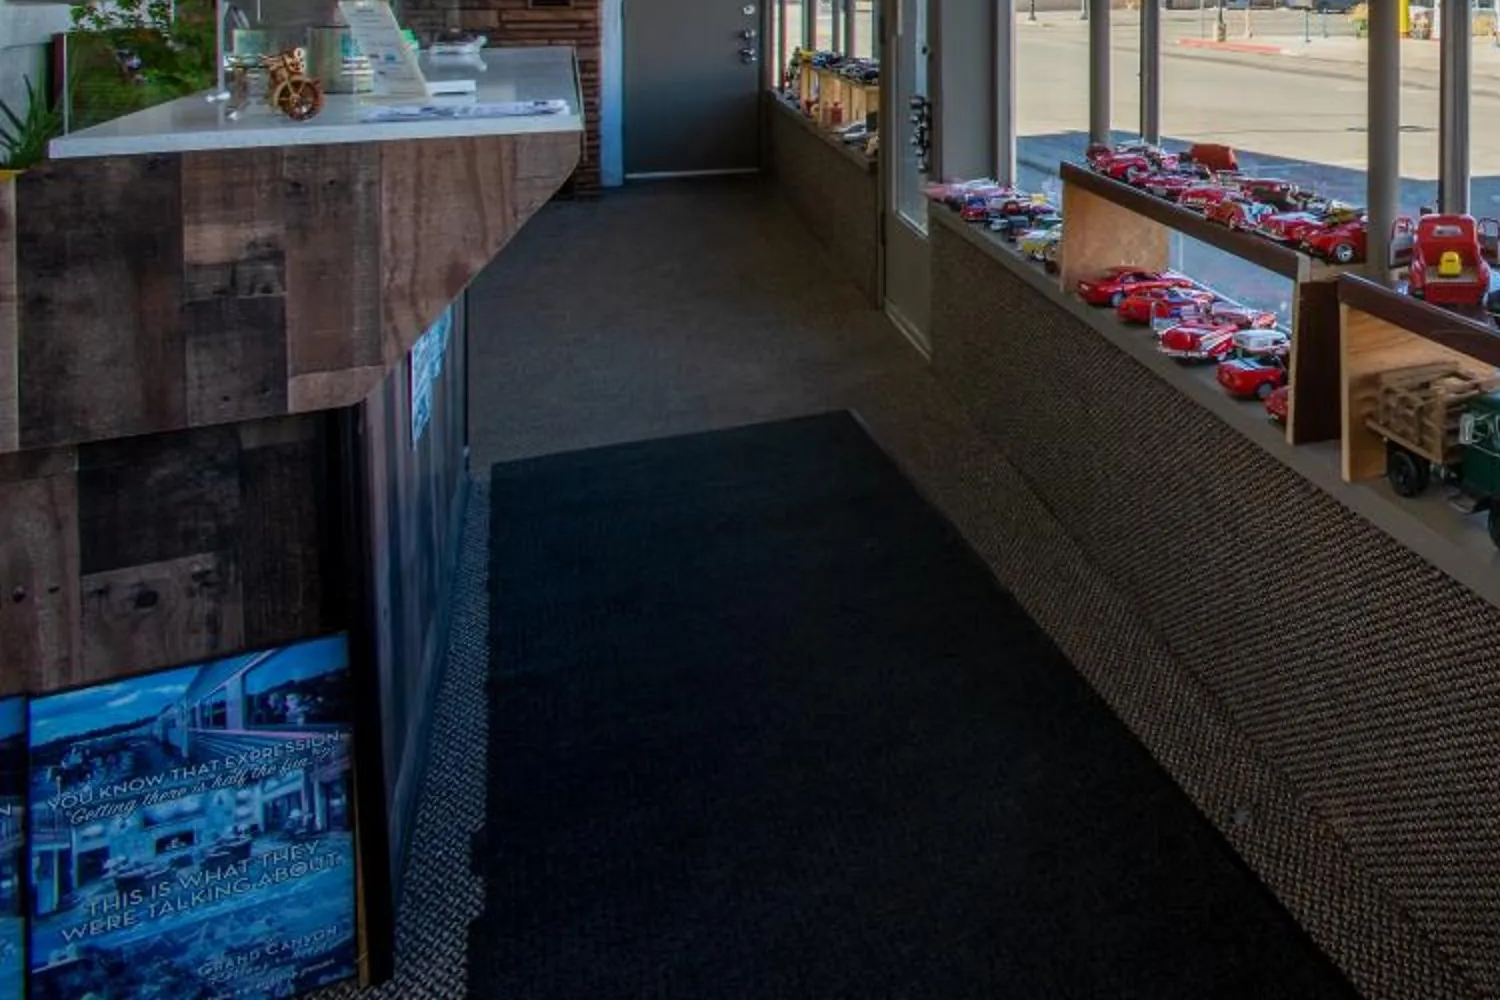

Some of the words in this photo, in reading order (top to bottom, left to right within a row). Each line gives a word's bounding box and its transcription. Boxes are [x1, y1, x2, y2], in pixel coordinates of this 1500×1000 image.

[48, 788, 92, 810] YOU
[100, 773, 164, 799] KNOW
[171, 759, 220, 780] THAT
[62, 909, 137, 941] WERE
[150, 877, 251, 918] TALKING
[90, 889, 143, 916] THIS
[152, 881, 170, 899] IS
[178, 859, 249, 889] WHAT
[263, 840, 320, 867] THEY
